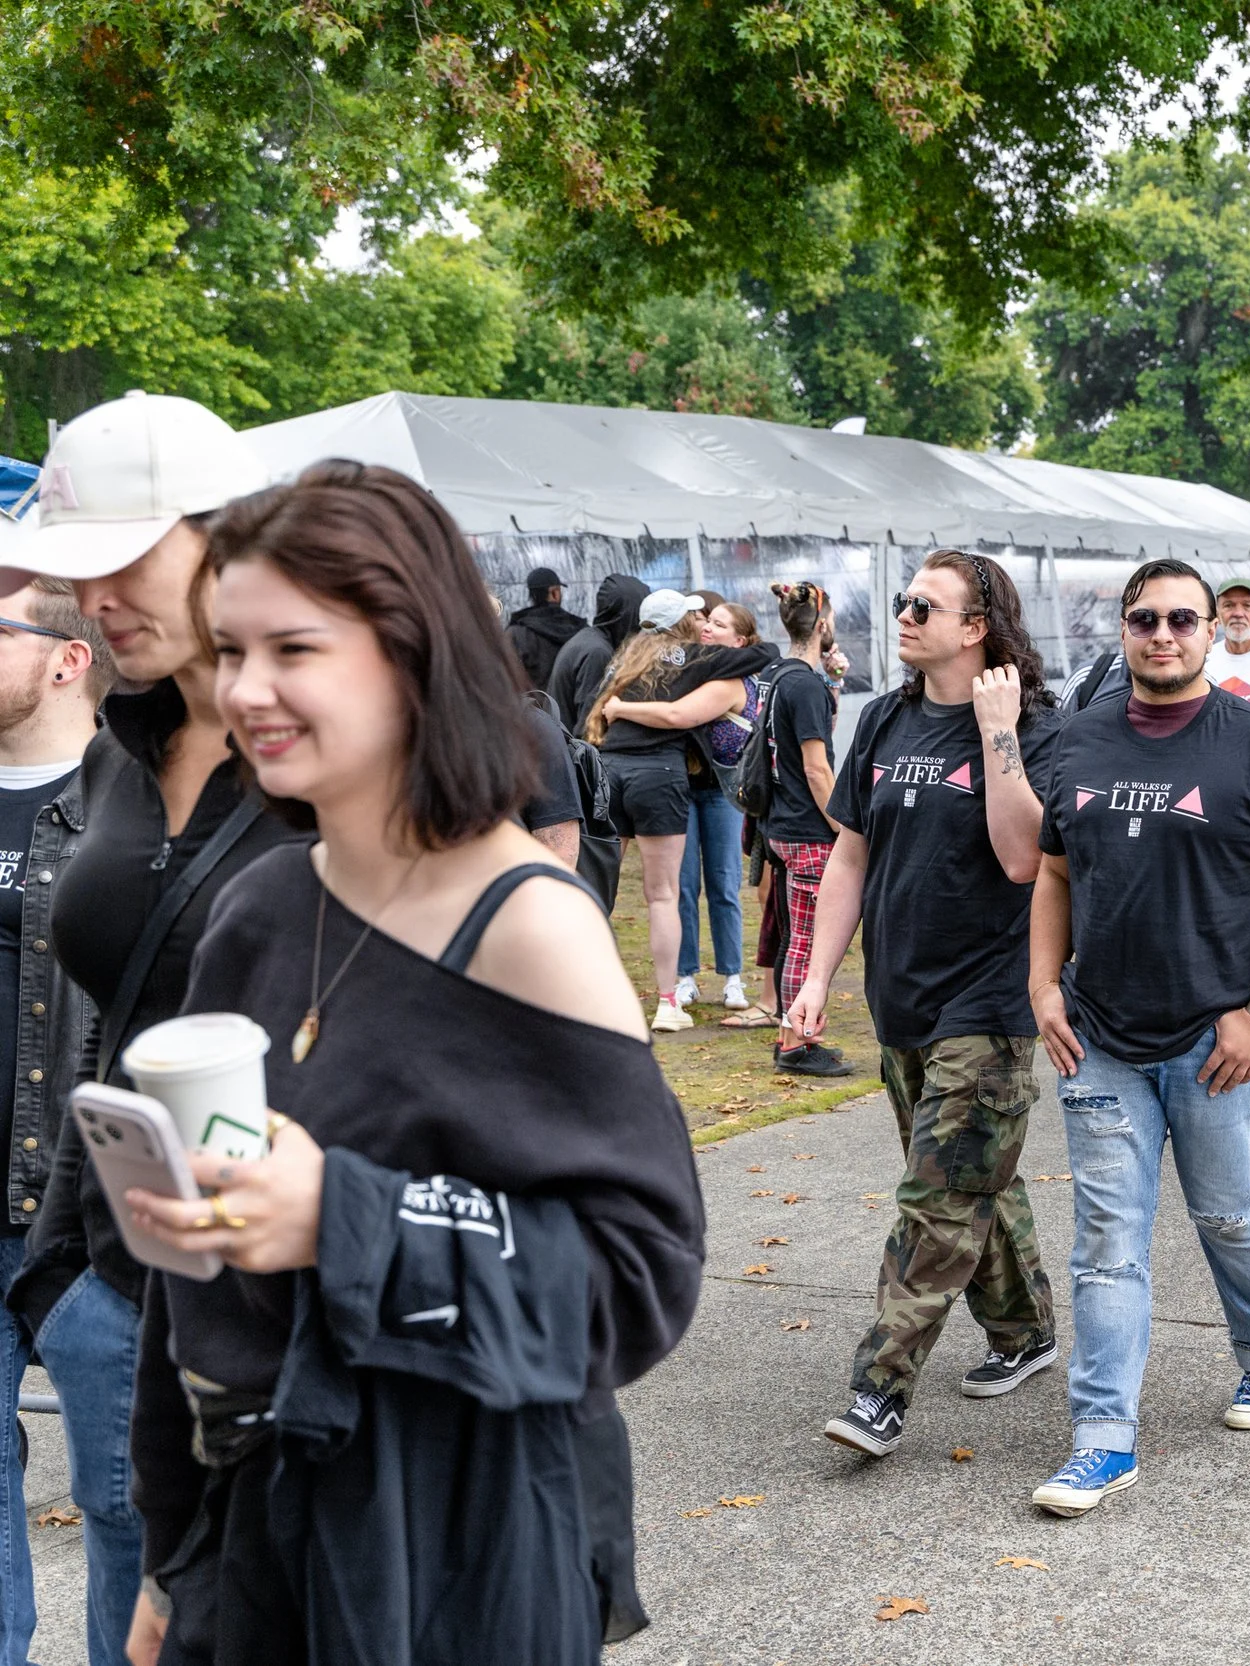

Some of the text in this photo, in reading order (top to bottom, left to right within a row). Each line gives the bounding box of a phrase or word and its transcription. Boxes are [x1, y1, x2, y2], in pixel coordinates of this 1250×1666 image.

[896, 755, 908, 763] ALL
[891, 764, 942, 784] LIFE
[1113, 781, 1172, 791] ALL WALKS OF
[1108, 789, 1170, 812] LIFE
[7, 850, 24, 861] OF
